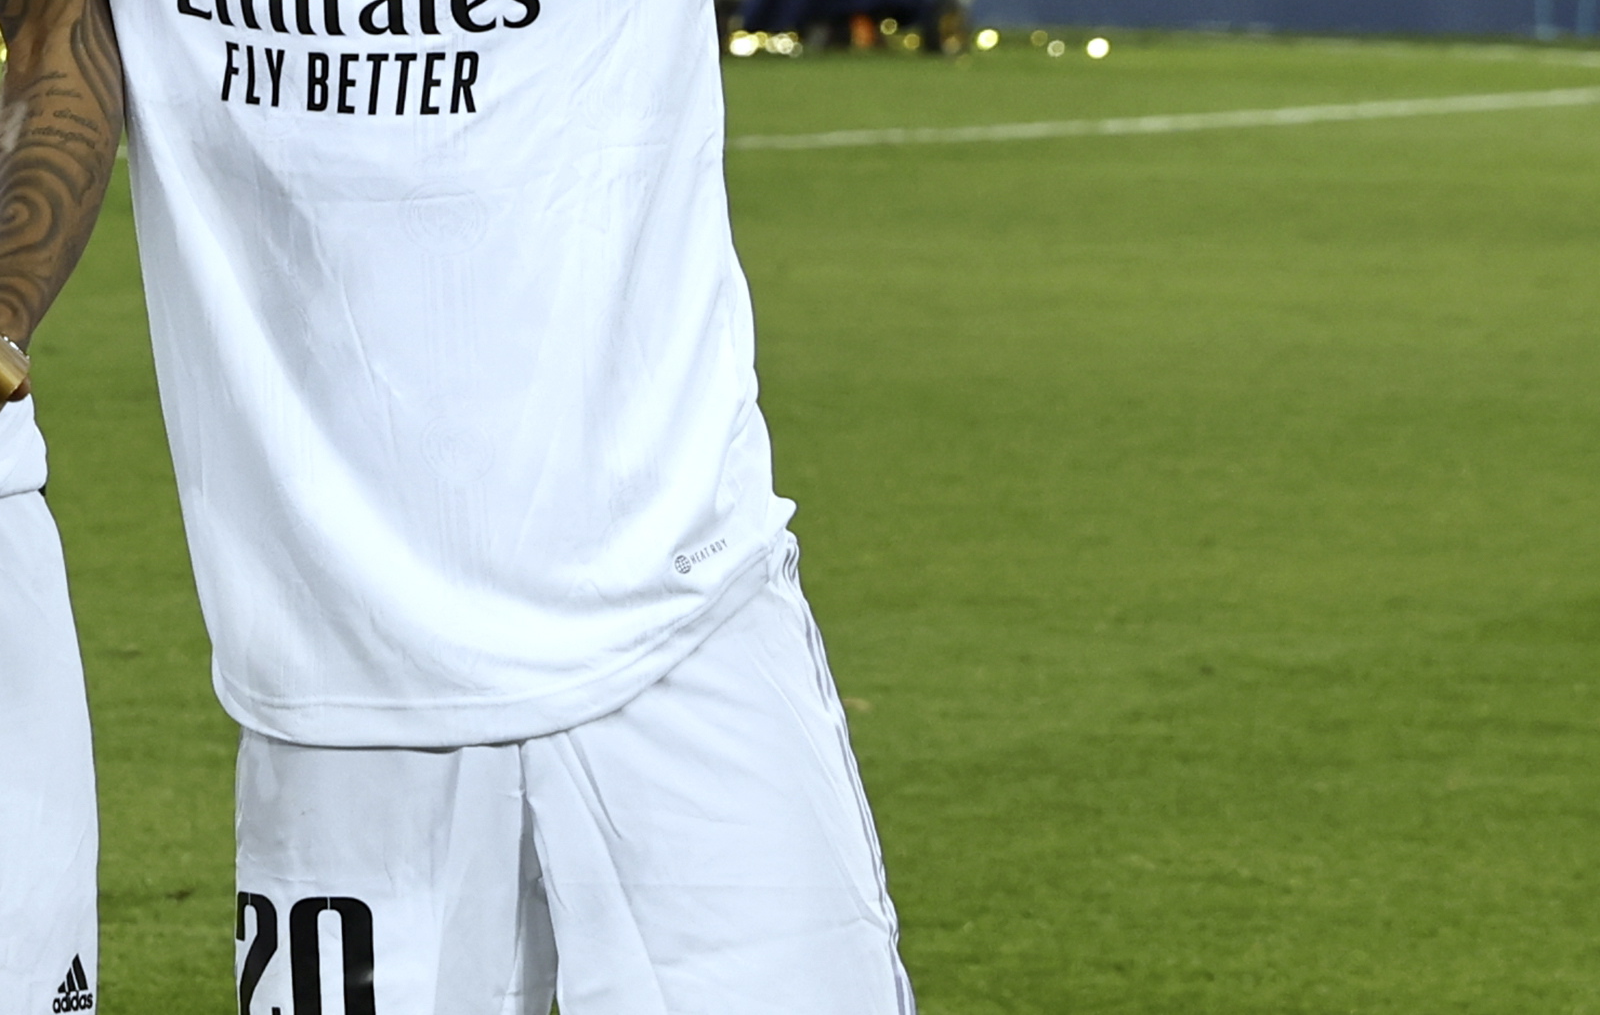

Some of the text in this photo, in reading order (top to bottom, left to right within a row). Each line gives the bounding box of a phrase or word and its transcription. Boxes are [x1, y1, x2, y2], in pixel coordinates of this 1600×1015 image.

[221, 41, 480, 116] FLY BETTER
[236, 891, 377, 1015] 20
[52, 990, 93, 1014] adidas
